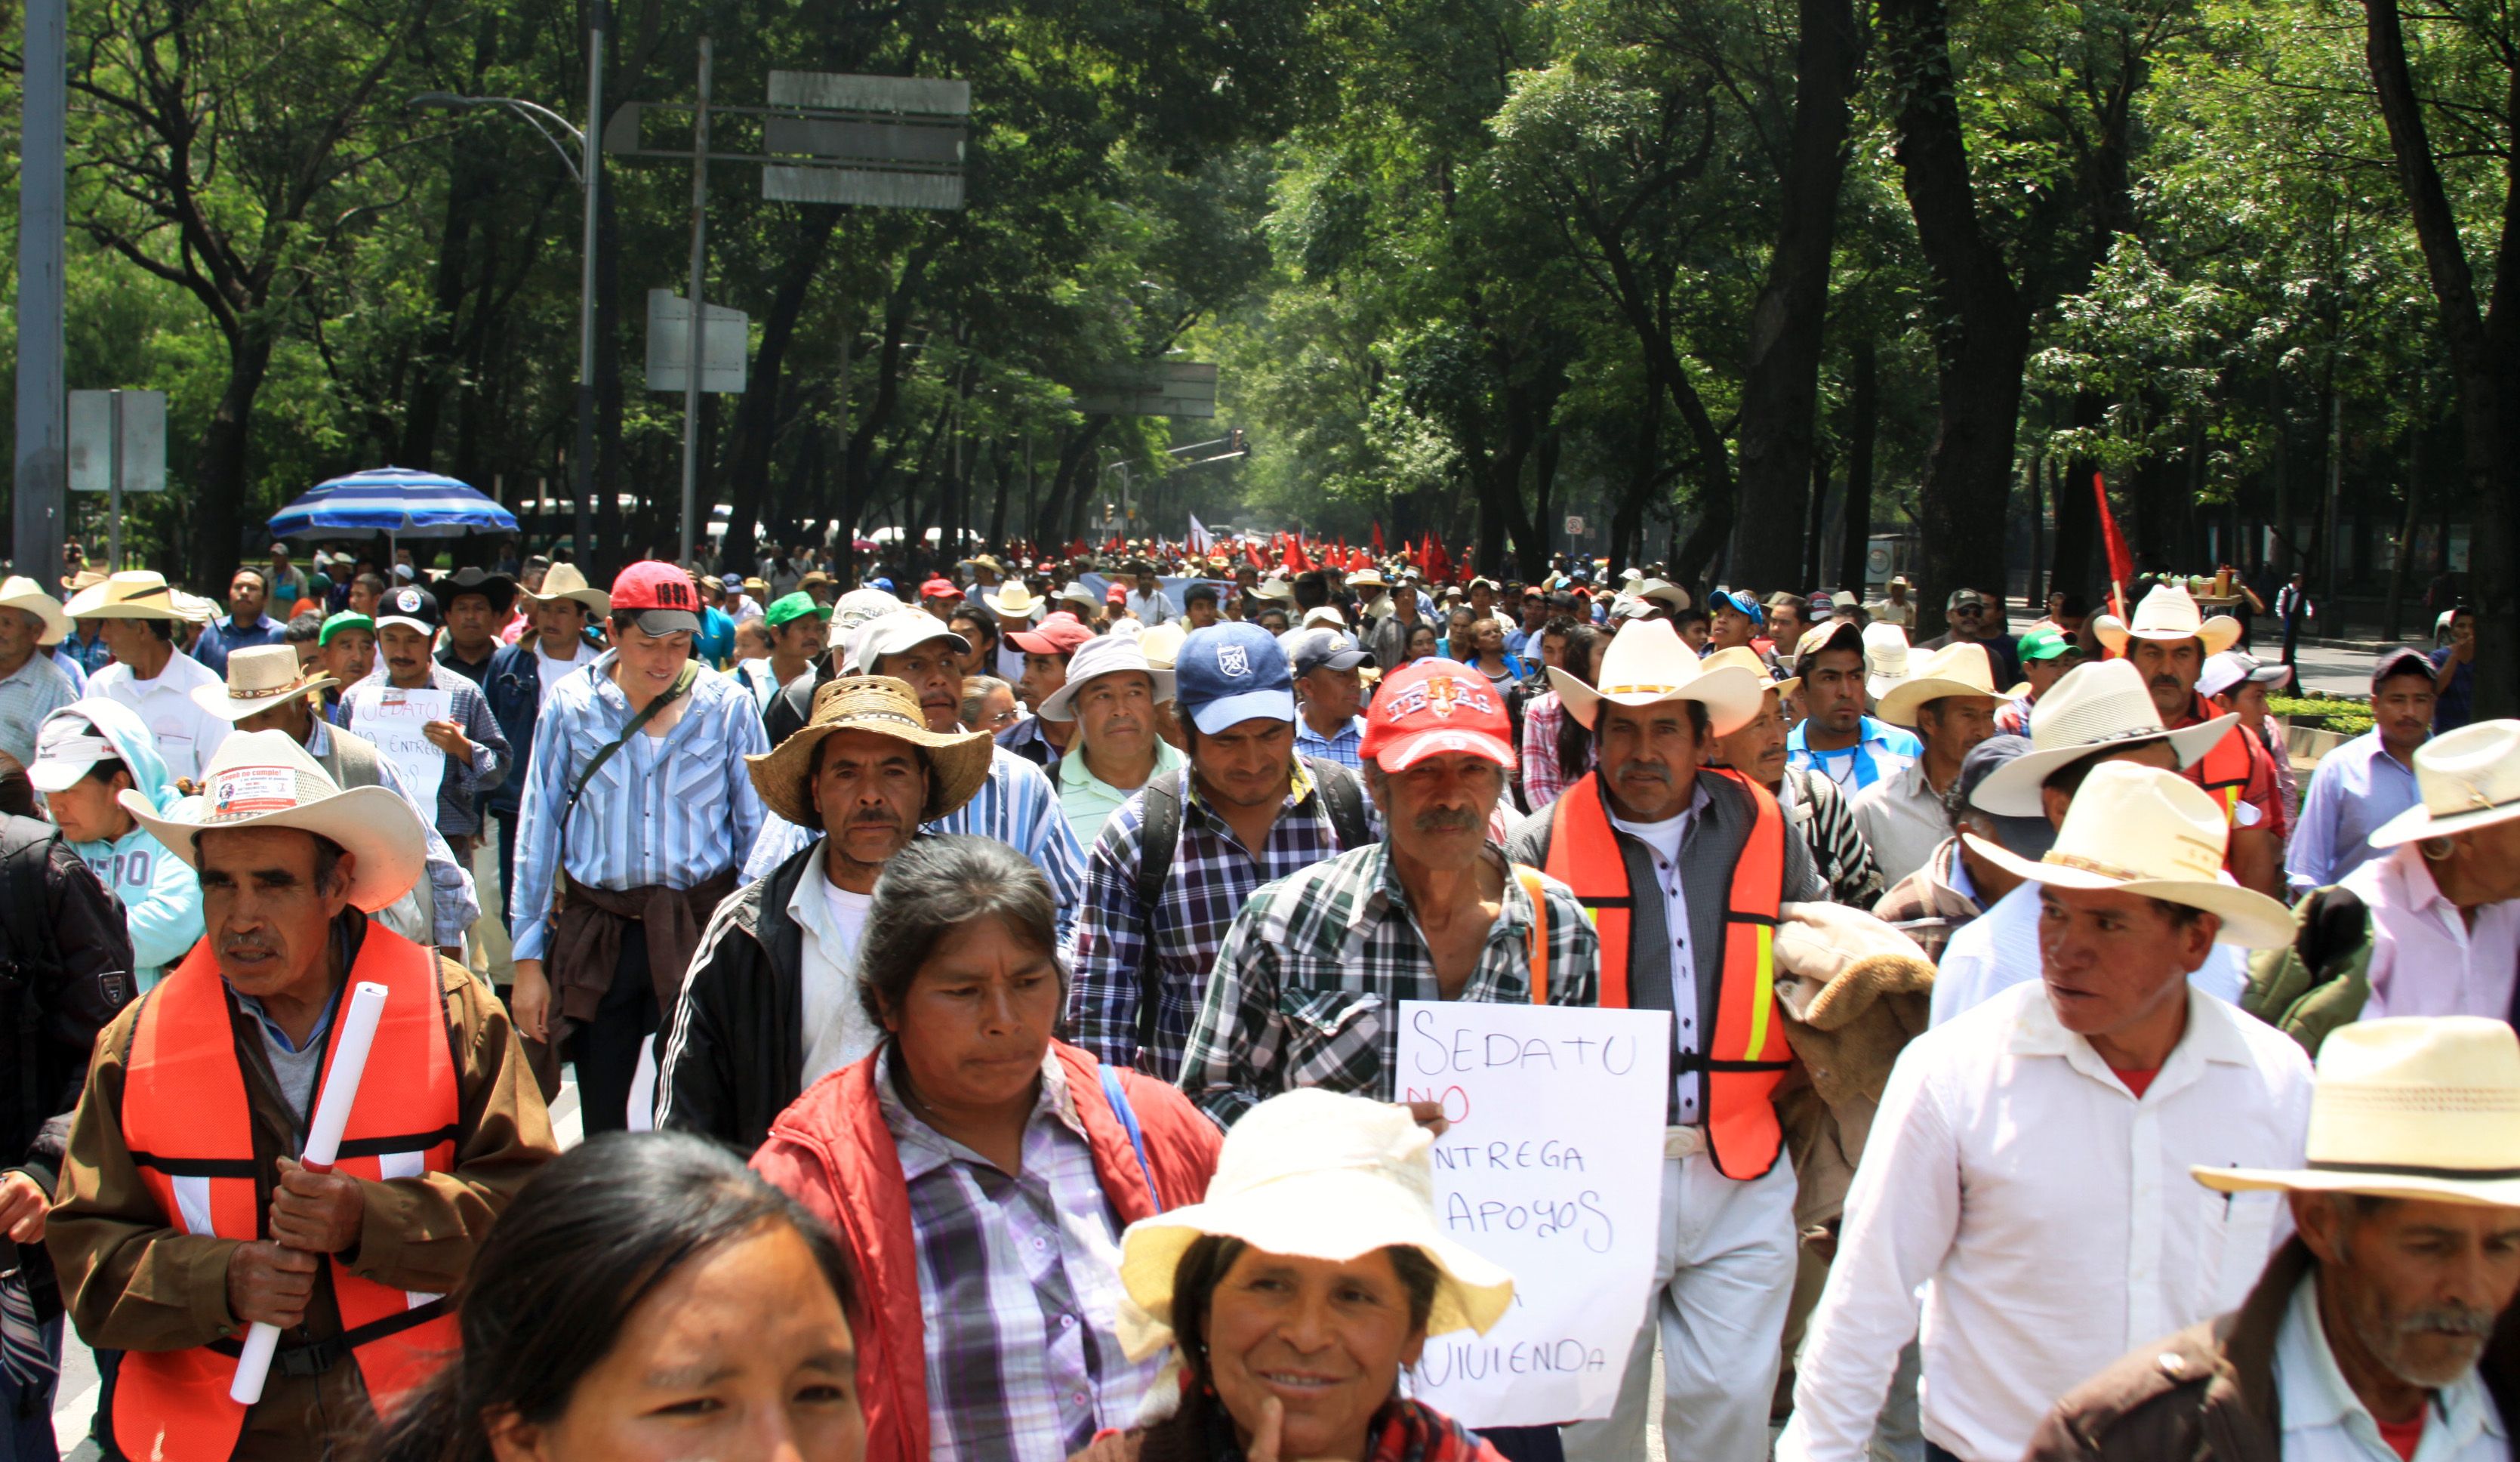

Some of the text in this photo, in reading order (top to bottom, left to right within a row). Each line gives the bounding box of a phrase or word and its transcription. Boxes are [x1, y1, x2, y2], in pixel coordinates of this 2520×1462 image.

[390, 735, 445, 758] ENTREG
[1414, 1010, 1637, 1075] SEDATU
[1435, 1140, 1585, 1172] NTREGA
